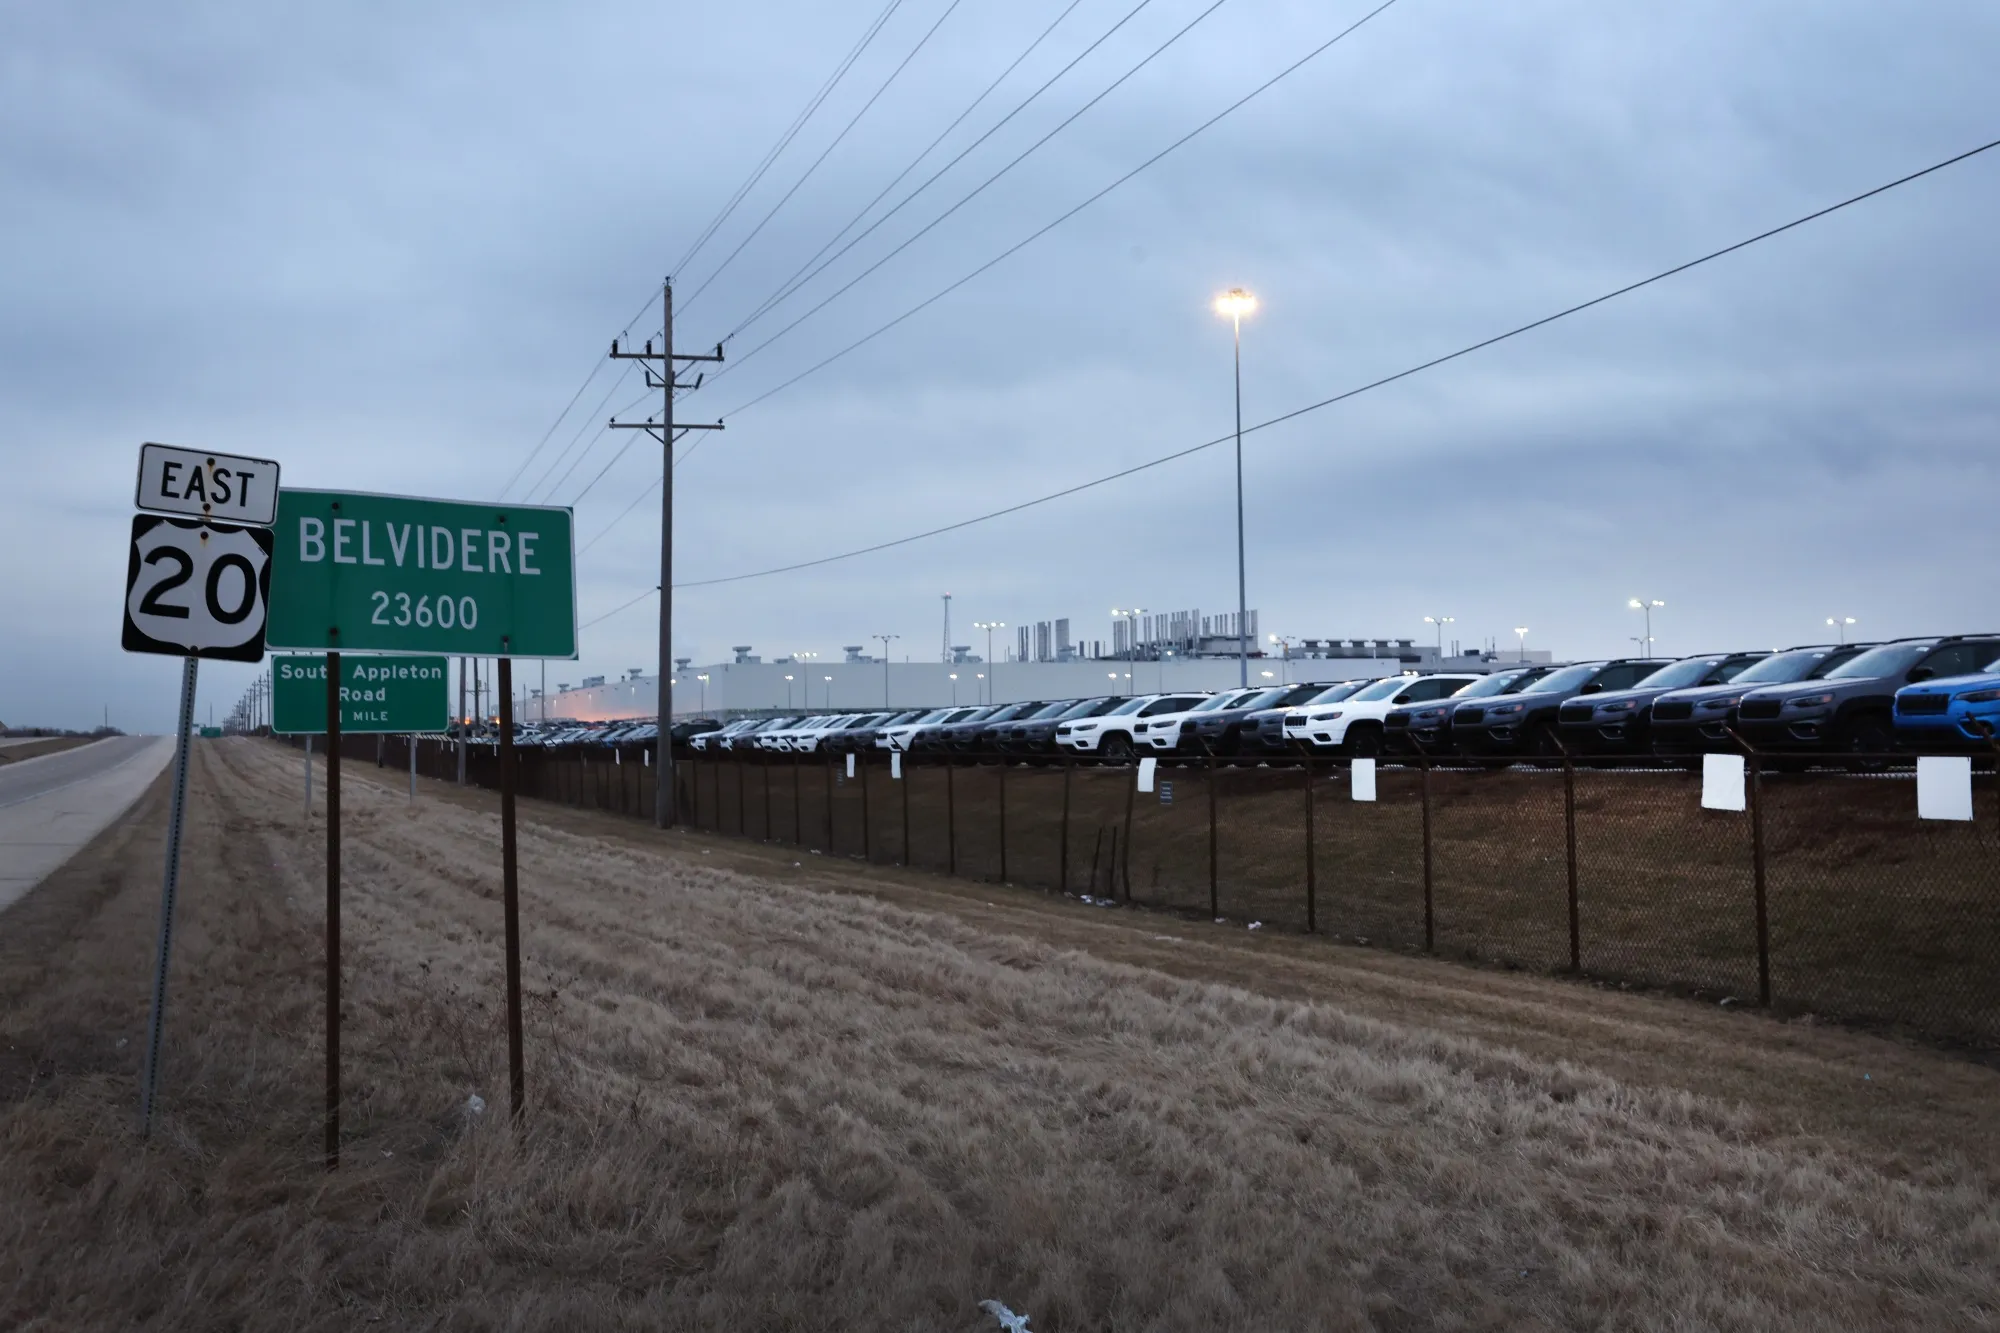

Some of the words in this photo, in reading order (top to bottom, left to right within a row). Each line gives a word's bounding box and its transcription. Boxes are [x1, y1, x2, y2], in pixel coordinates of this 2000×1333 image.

[160, 461, 255, 507] EAST
[298, 517, 542, 576] BELVIDERE
[139, 545, 257, 625] 20
[370, 590, 478, 630] 23600
[280, 664, 328, 679] Sout
[352, 664, 442, 681] Appleton
[339, 687, 386, 701] Road
[353, 711, 389, 721] MILE
